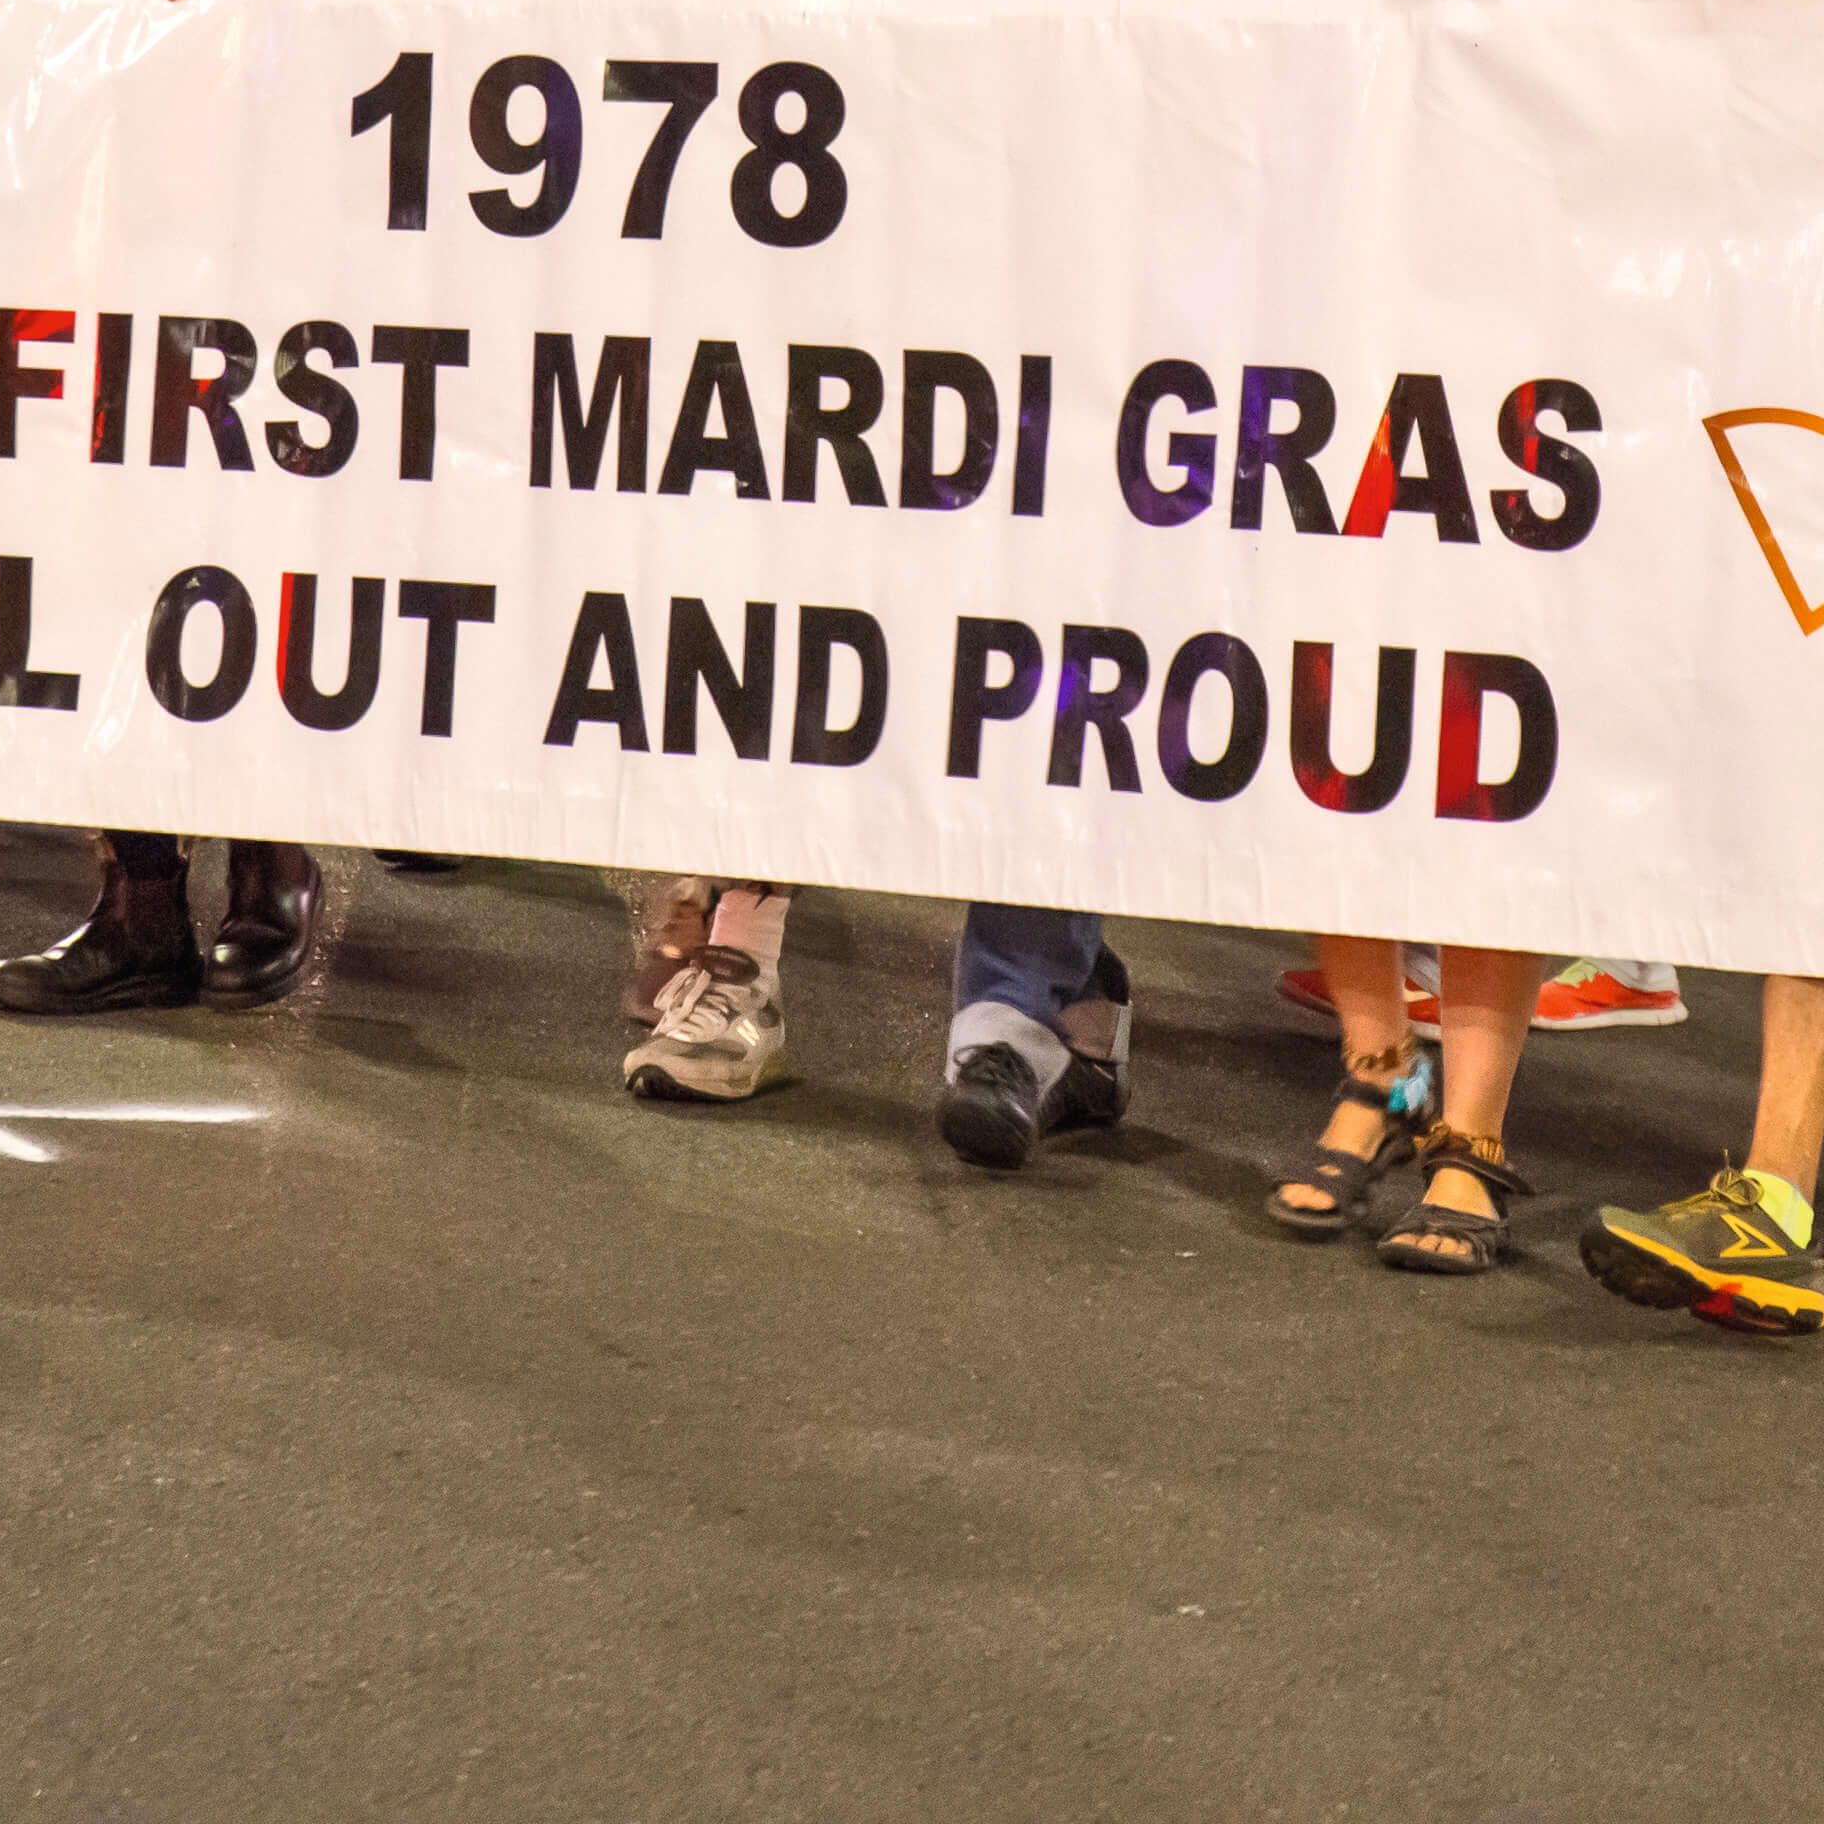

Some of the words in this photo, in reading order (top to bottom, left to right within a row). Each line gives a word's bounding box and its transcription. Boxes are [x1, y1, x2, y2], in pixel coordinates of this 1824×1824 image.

[351, 52, 847, 248] 1978
[529, 332, 1052, 517] MARDI
[1116, 358, 1602, 552] GRAS
[145, 565, 496, 738] OUT
[543, 591, 888, 767] AND
[946, 615, 1558, 823] PROUD
